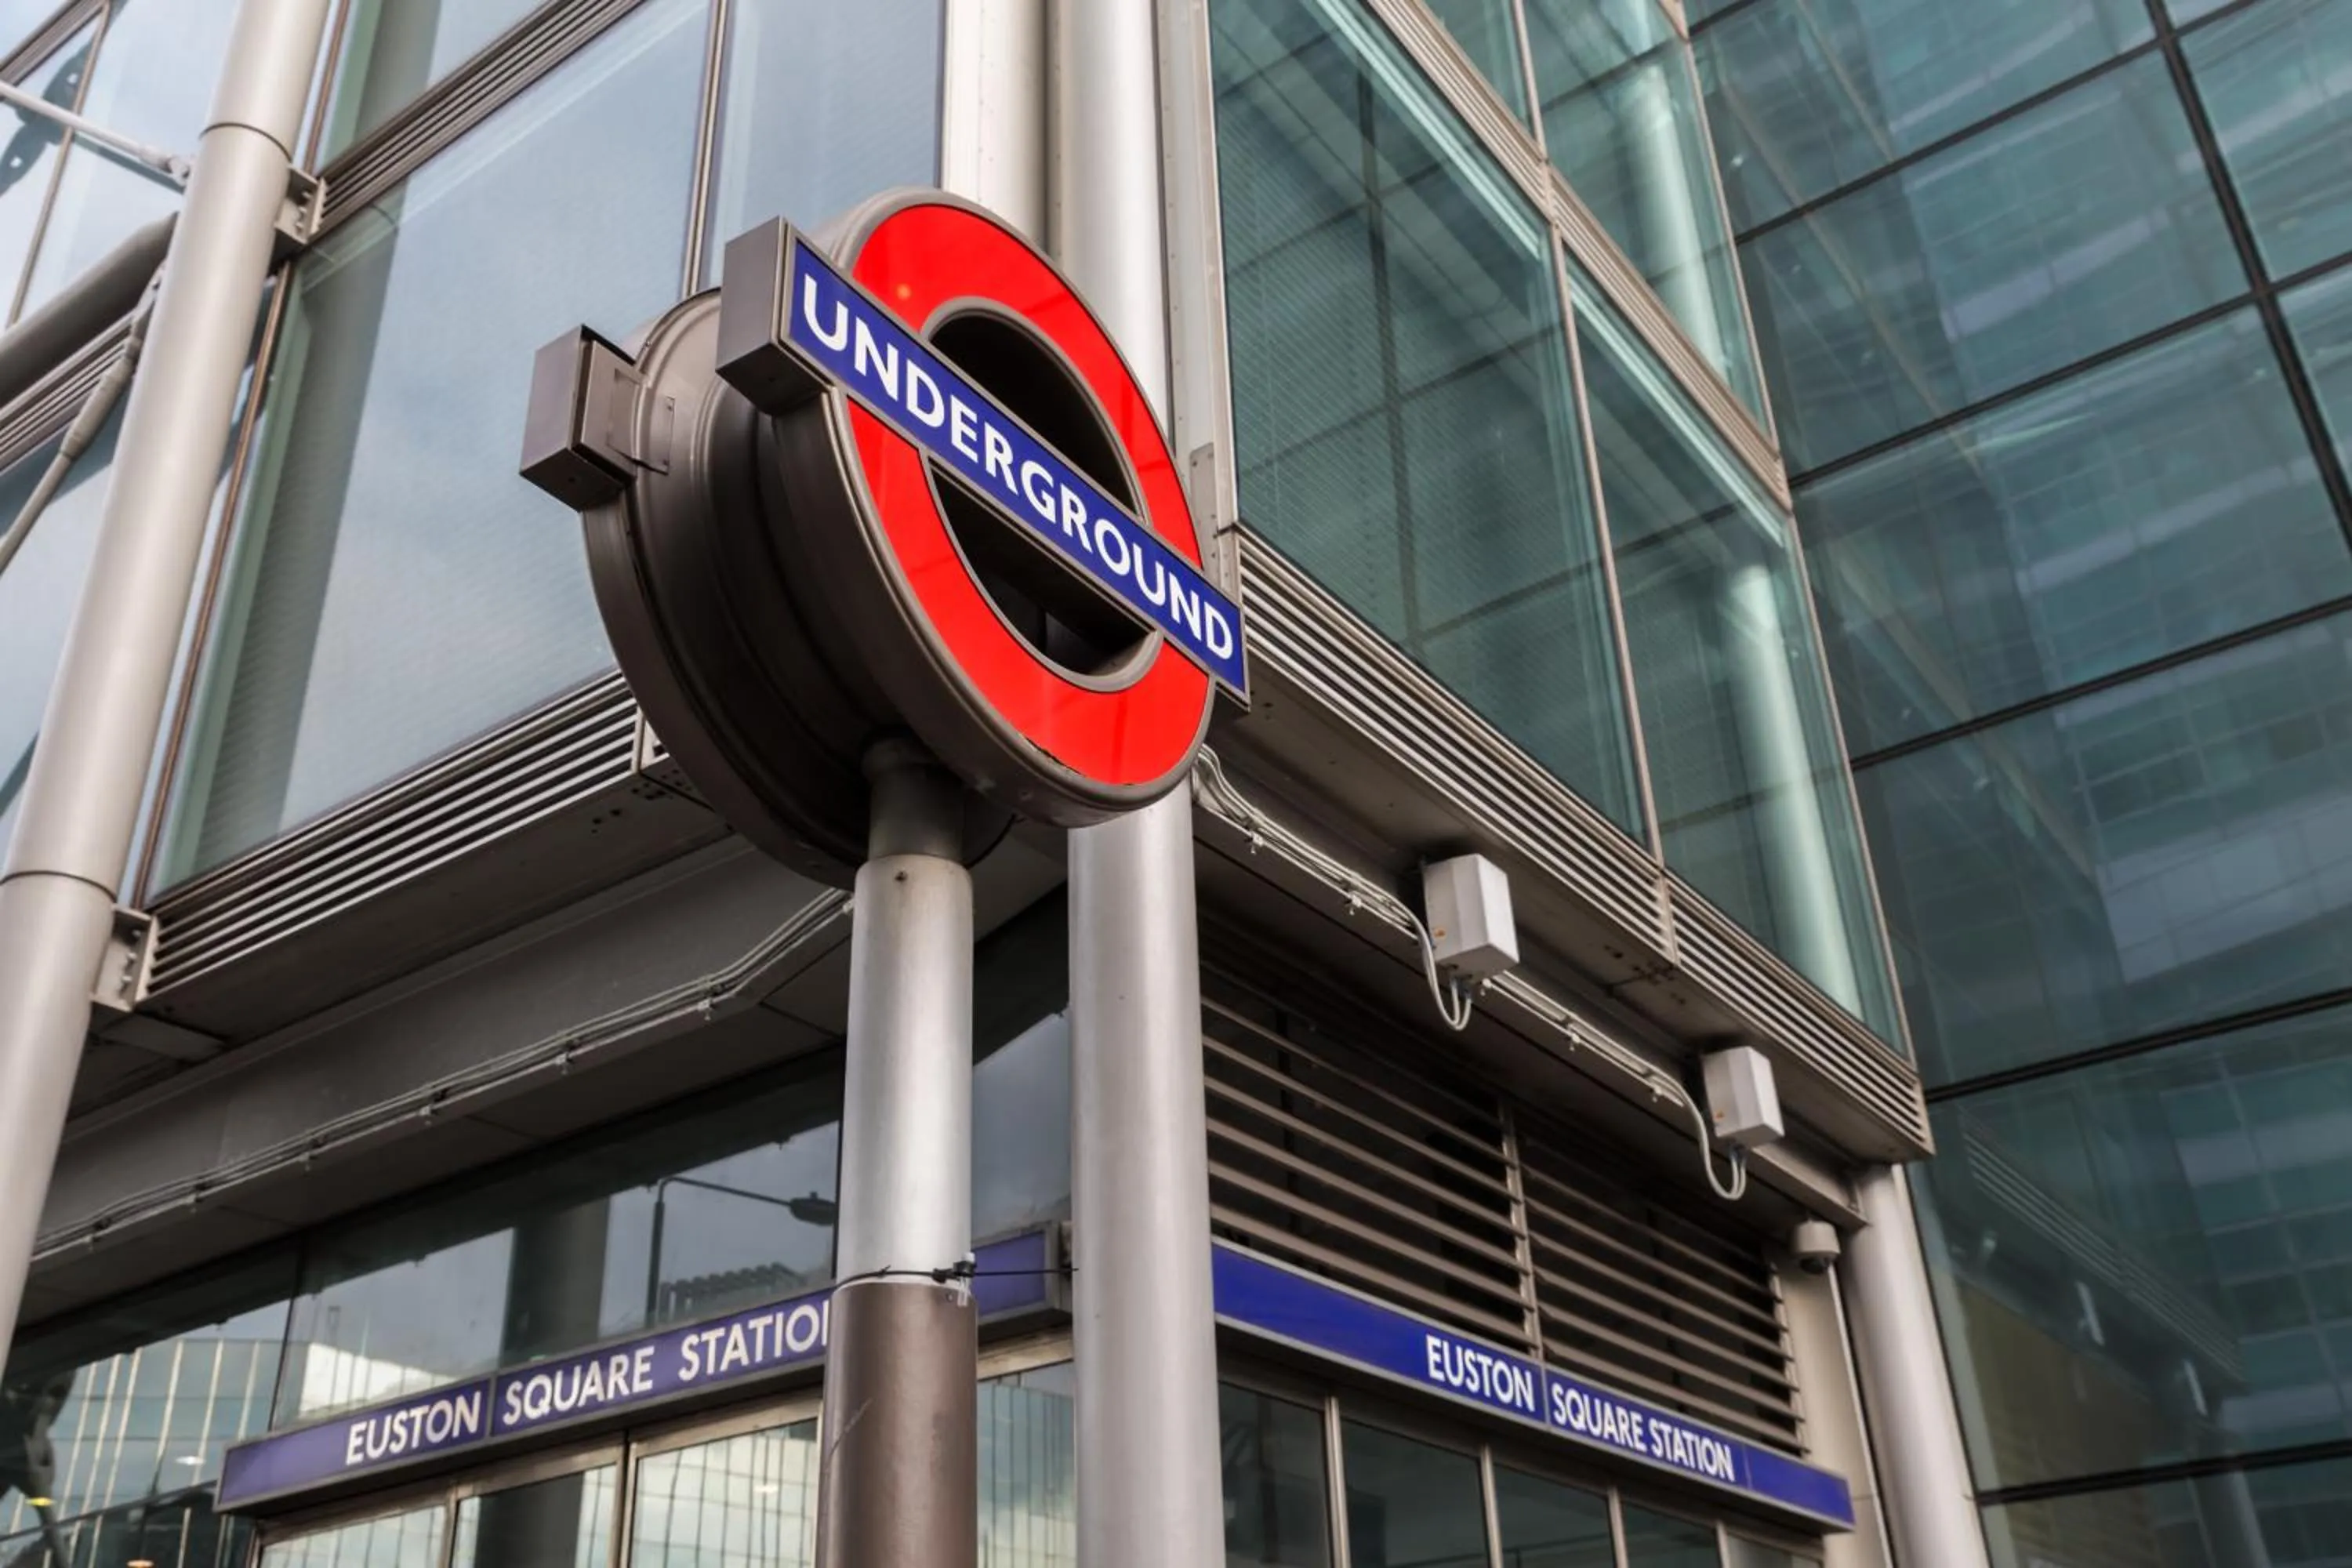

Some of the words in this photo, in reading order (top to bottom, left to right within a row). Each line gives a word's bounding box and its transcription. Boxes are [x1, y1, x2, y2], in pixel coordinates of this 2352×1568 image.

[804, 274, 1234, 660] UNDERGROUND
[346, 1390, 481, 1465] EUSTON
[503, 1345, 655, 1425] SQUARE
[678, 1299, 829, 1381] STATIO
[1426, 1334, 1535, 1412] EUSTON
[1552, 1382, 1647, 1450] SQUARE
[1649, 1417, 1735, 1482] STATION
